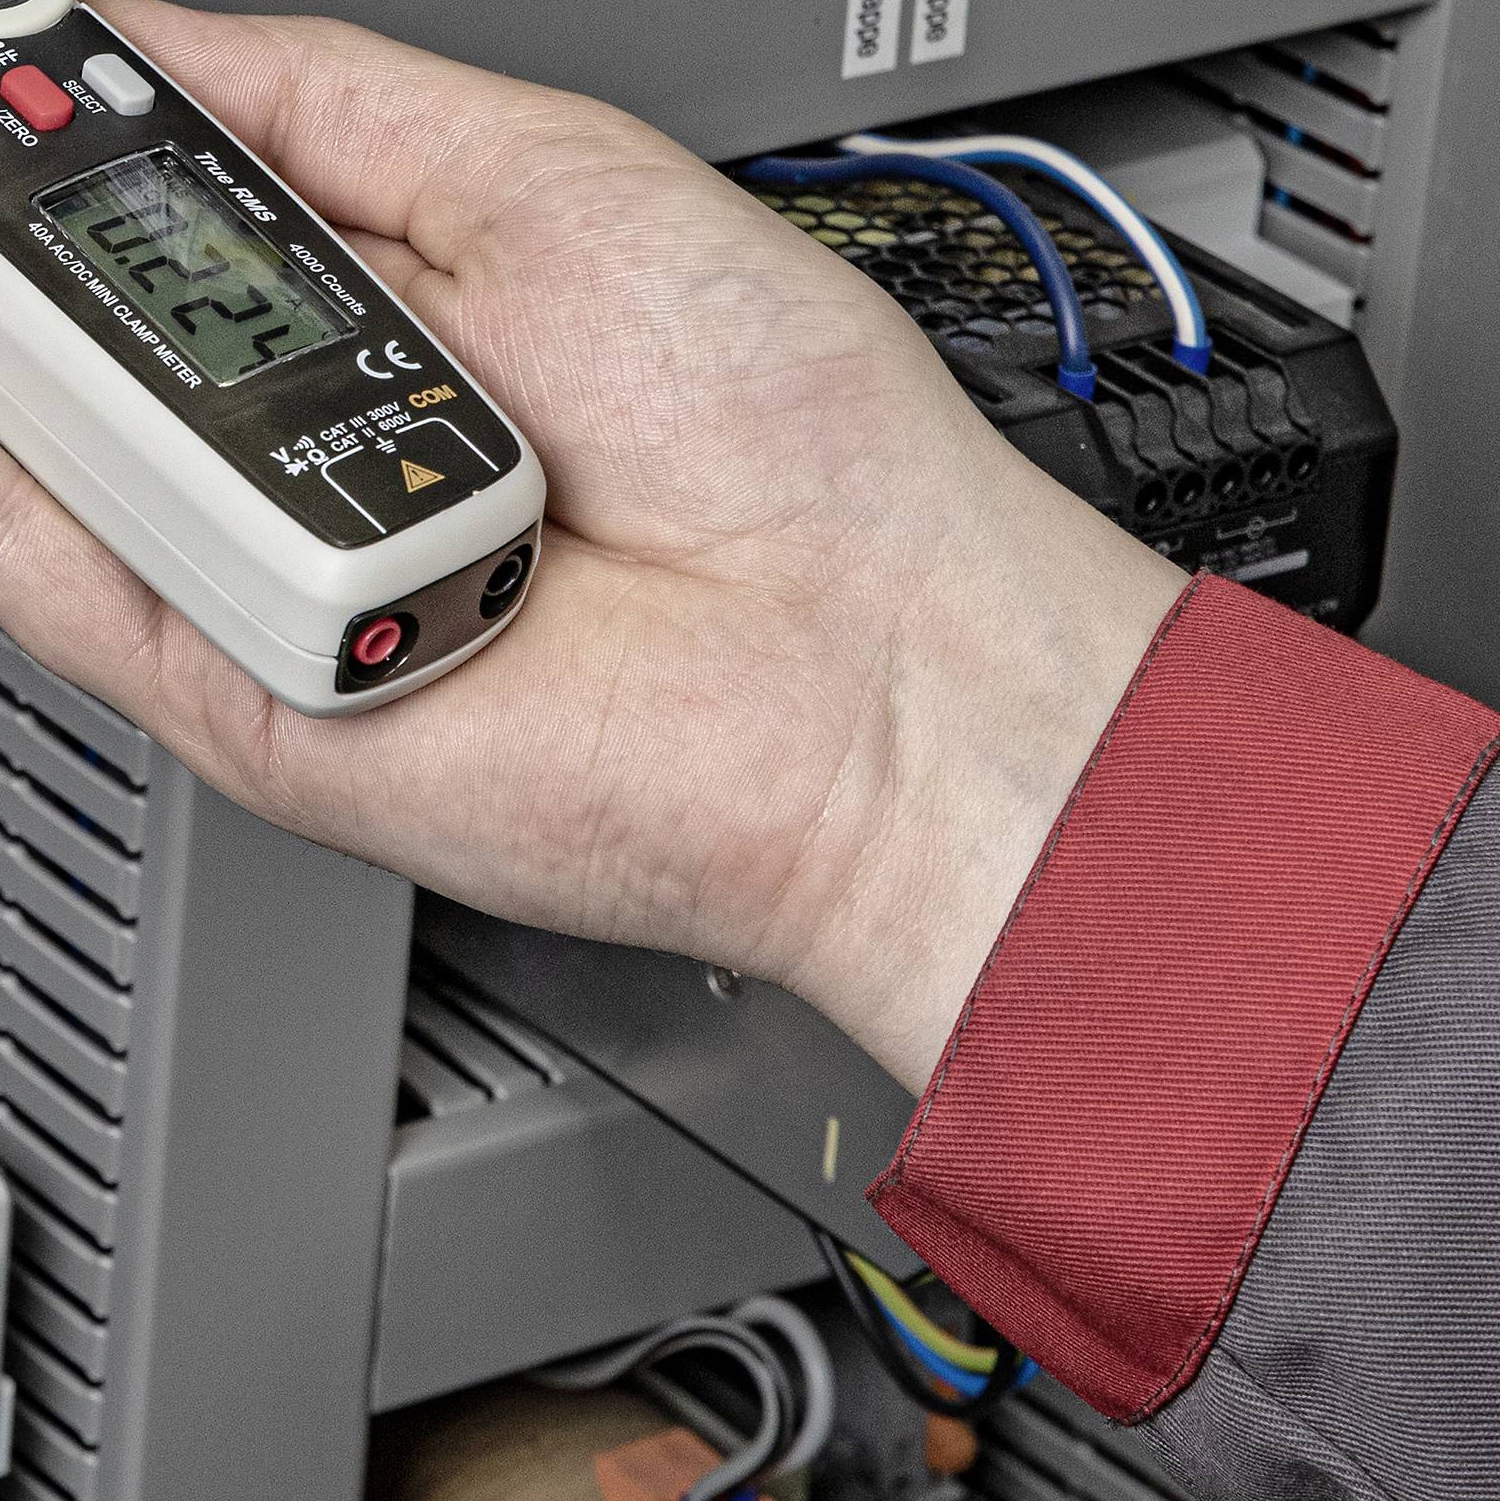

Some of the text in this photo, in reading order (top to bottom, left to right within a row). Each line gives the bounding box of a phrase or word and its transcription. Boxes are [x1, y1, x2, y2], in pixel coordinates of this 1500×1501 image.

[62, 78, 106, 115] SELECT
[194, 152, 366, 316] True RMS 4000 Counts
[28, 221, 202, 389] 40A AC/DC MINI CLAMP METER
[408, 384, 457, 409] COM
[319, 401, 402, 442] CAT III 300V
[330, 412, 413, 452] CAT II 600V
